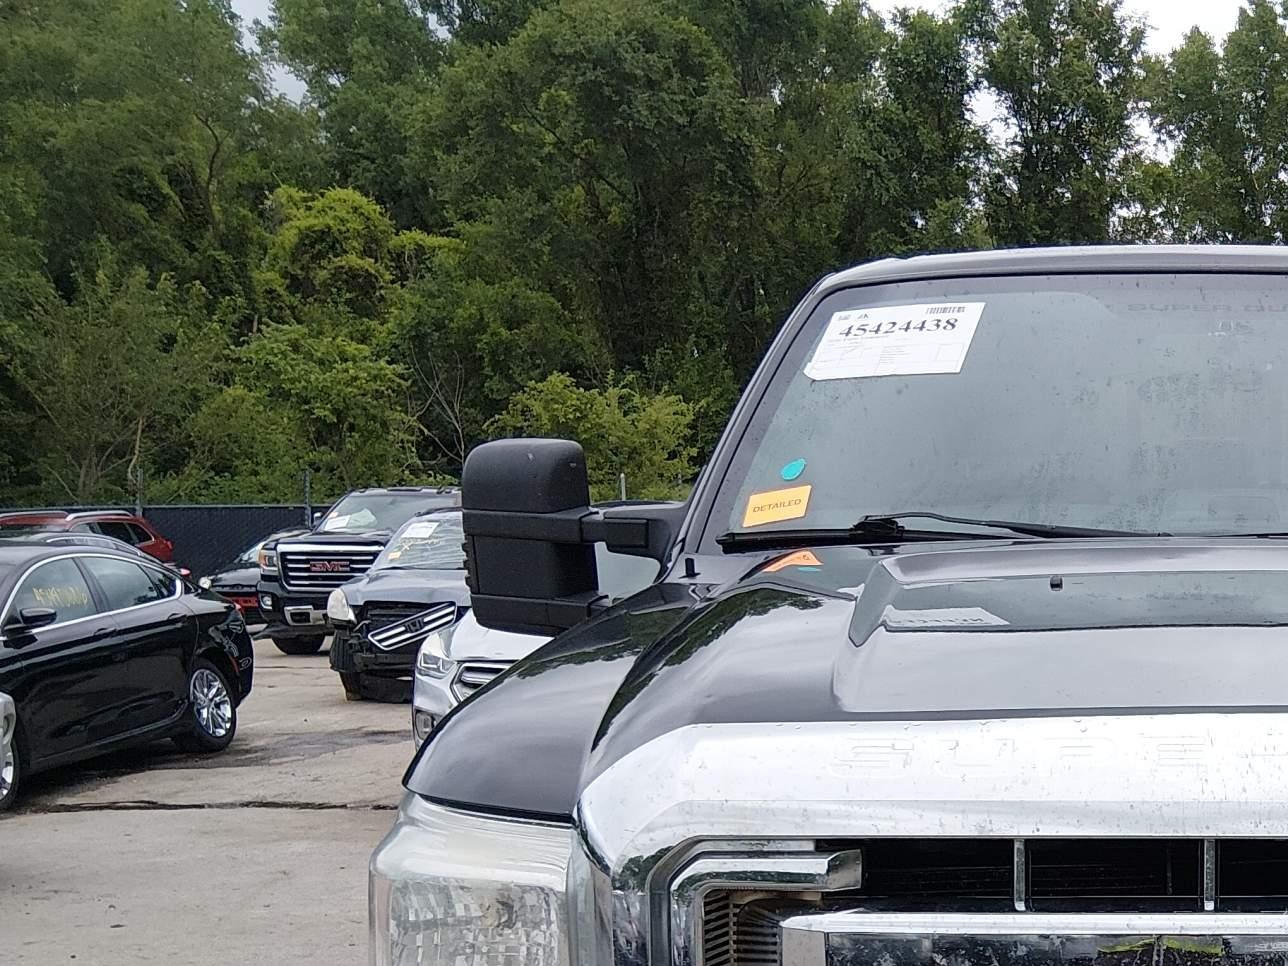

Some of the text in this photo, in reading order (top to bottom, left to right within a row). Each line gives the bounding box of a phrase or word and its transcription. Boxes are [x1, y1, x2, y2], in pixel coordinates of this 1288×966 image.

[839, 317, 959, 338] 45424438
[752, 497, 803, 514] DETAILED
[310, 560, 350, 572] GMC
